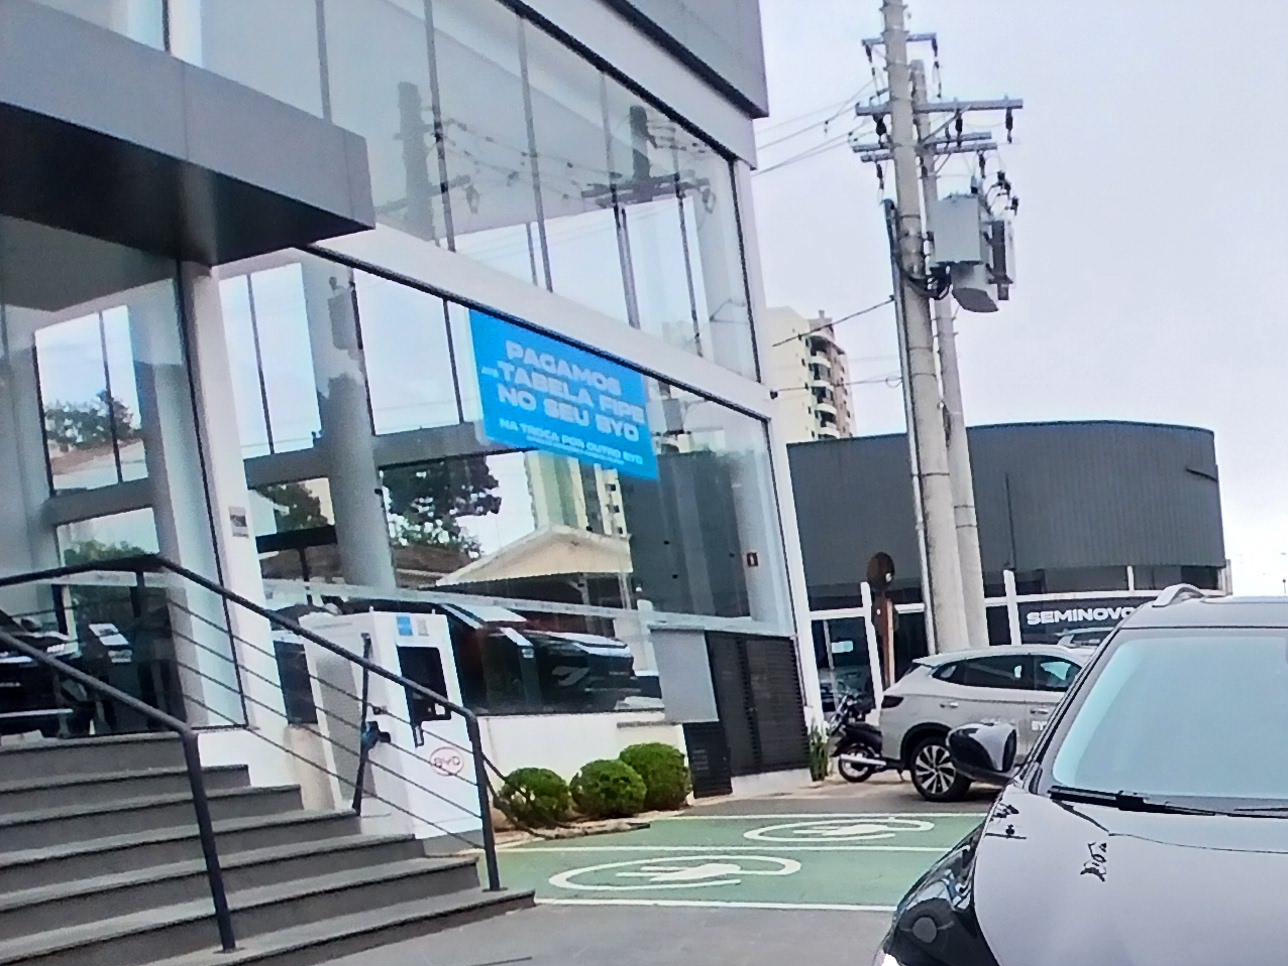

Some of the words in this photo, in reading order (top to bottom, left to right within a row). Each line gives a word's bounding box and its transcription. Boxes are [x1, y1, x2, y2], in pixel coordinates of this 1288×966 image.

[497, 360, 595, 408] TABELA
[599, 394, 645, 424] FIPE
[505, 340, 622, 395] PAGAMOS
[497, 383, 537, 411] NO
[543, 398, 590, 427] SEU
[595, 414, 640, 442] BYD
[1026, 606, 1135, 625] SEMINOVO
